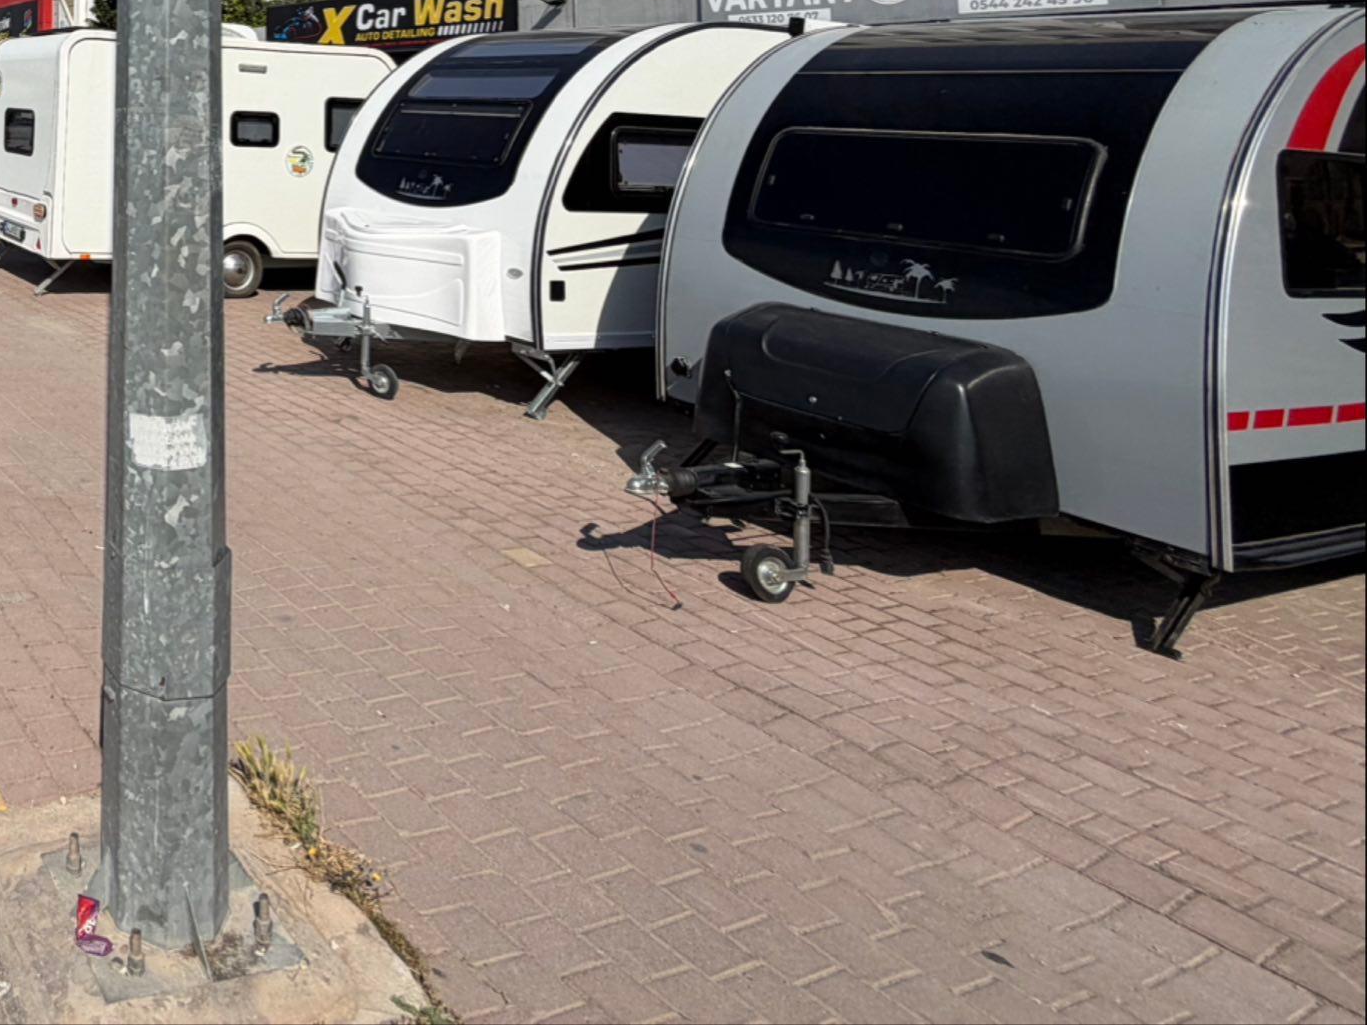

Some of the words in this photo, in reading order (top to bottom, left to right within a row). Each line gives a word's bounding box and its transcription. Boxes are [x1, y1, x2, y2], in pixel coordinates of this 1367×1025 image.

[320, 4, 356, 44] X
[356, 3, 406, 30] Car
[767, 14, 785, 23] 120
[355, 31, 380, 42] AUTO
[382, 28, 436, 40] DETAILING
